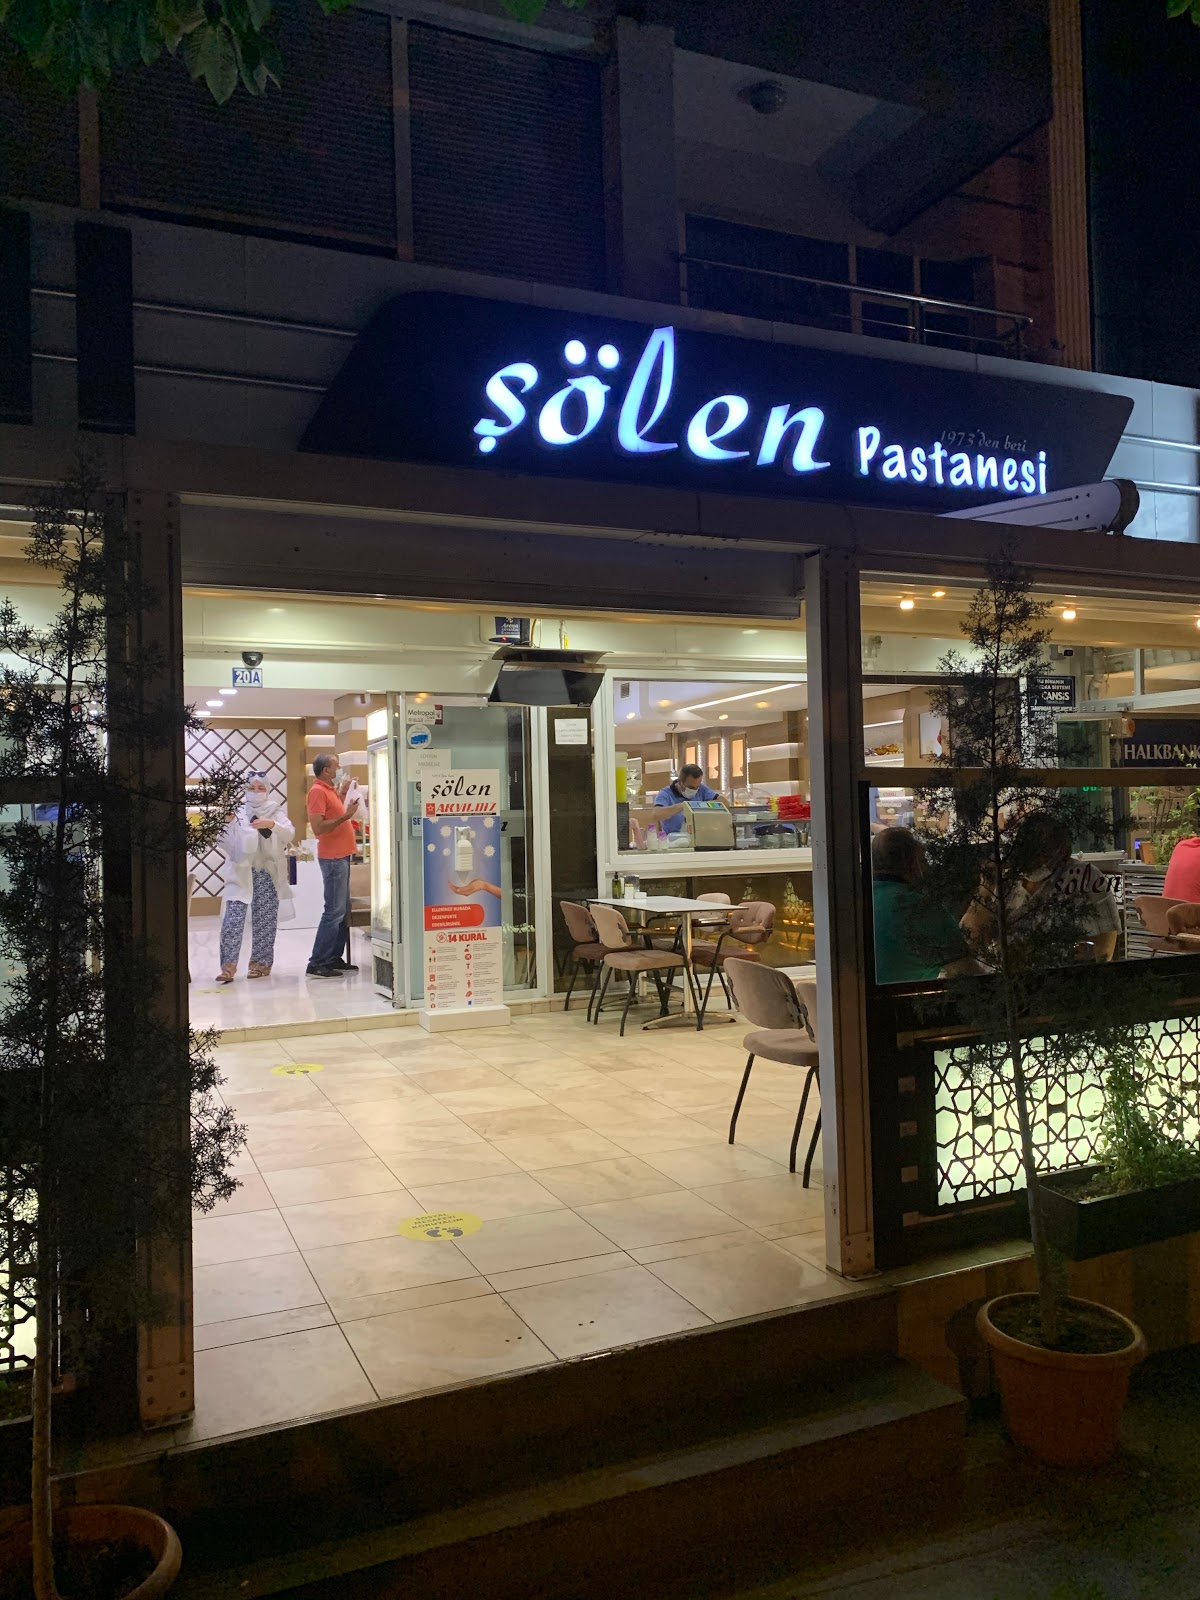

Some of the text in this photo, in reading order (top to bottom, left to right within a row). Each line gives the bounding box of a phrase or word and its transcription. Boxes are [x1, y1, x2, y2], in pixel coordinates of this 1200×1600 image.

[474, 326, 831, 471] şölen
[1004, 435, 1027, 452] beri
[858, 426, 1047, 494] Pastanesi
[407, 709, 435, 717] Metropol
[431, 775, 492, 799] şölen
[447, 934, 458, 943] 14
[459, 932, 488, 943] KURAL
